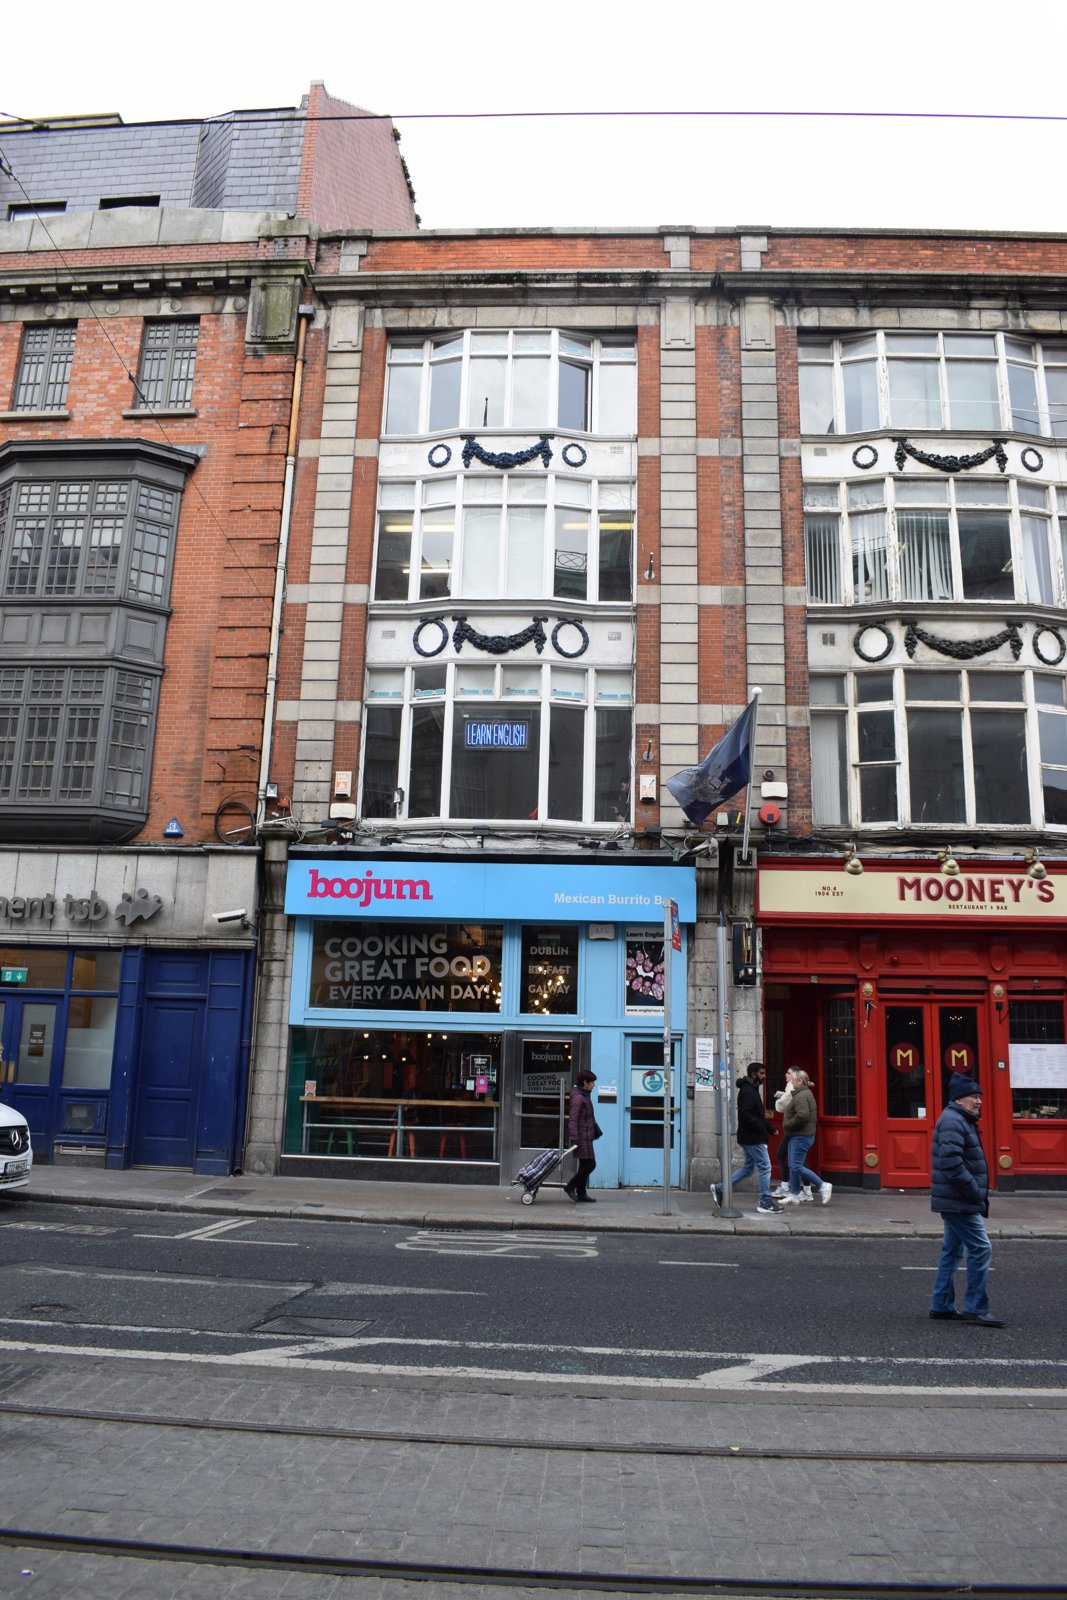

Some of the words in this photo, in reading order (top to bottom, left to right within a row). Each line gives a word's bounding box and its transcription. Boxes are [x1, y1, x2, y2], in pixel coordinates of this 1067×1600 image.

[467, 724, 492, 745] LEARN
[493, 724, 525, 746] ENGLISH
[307, 870, 433, 907] boojum
[897, 876, 1055, 903] MOONEY'S
[62, 890, 108, 920] tsb
[554, 893, 605, 904] Mexican
[608, 894, 651, 905] Burrito
[324, 934, 448, 958] COOKING
[530, 946, 569, 955] DUBLIN
[324, 959, 407, 982] GREAT
[416, 955, 491, 979] FOOD
[330, 986, 386, 1000] EVERY
[390, 985, 444, 1000] DAMN
[450, 984, 491, 1000] DAY!
[528, 985, 570, 994] GALWAY
[531, 1052, 563, 1062] boojum
[897, 1050, 913, 1066] M
[951, 1050, 968, 1067] M
